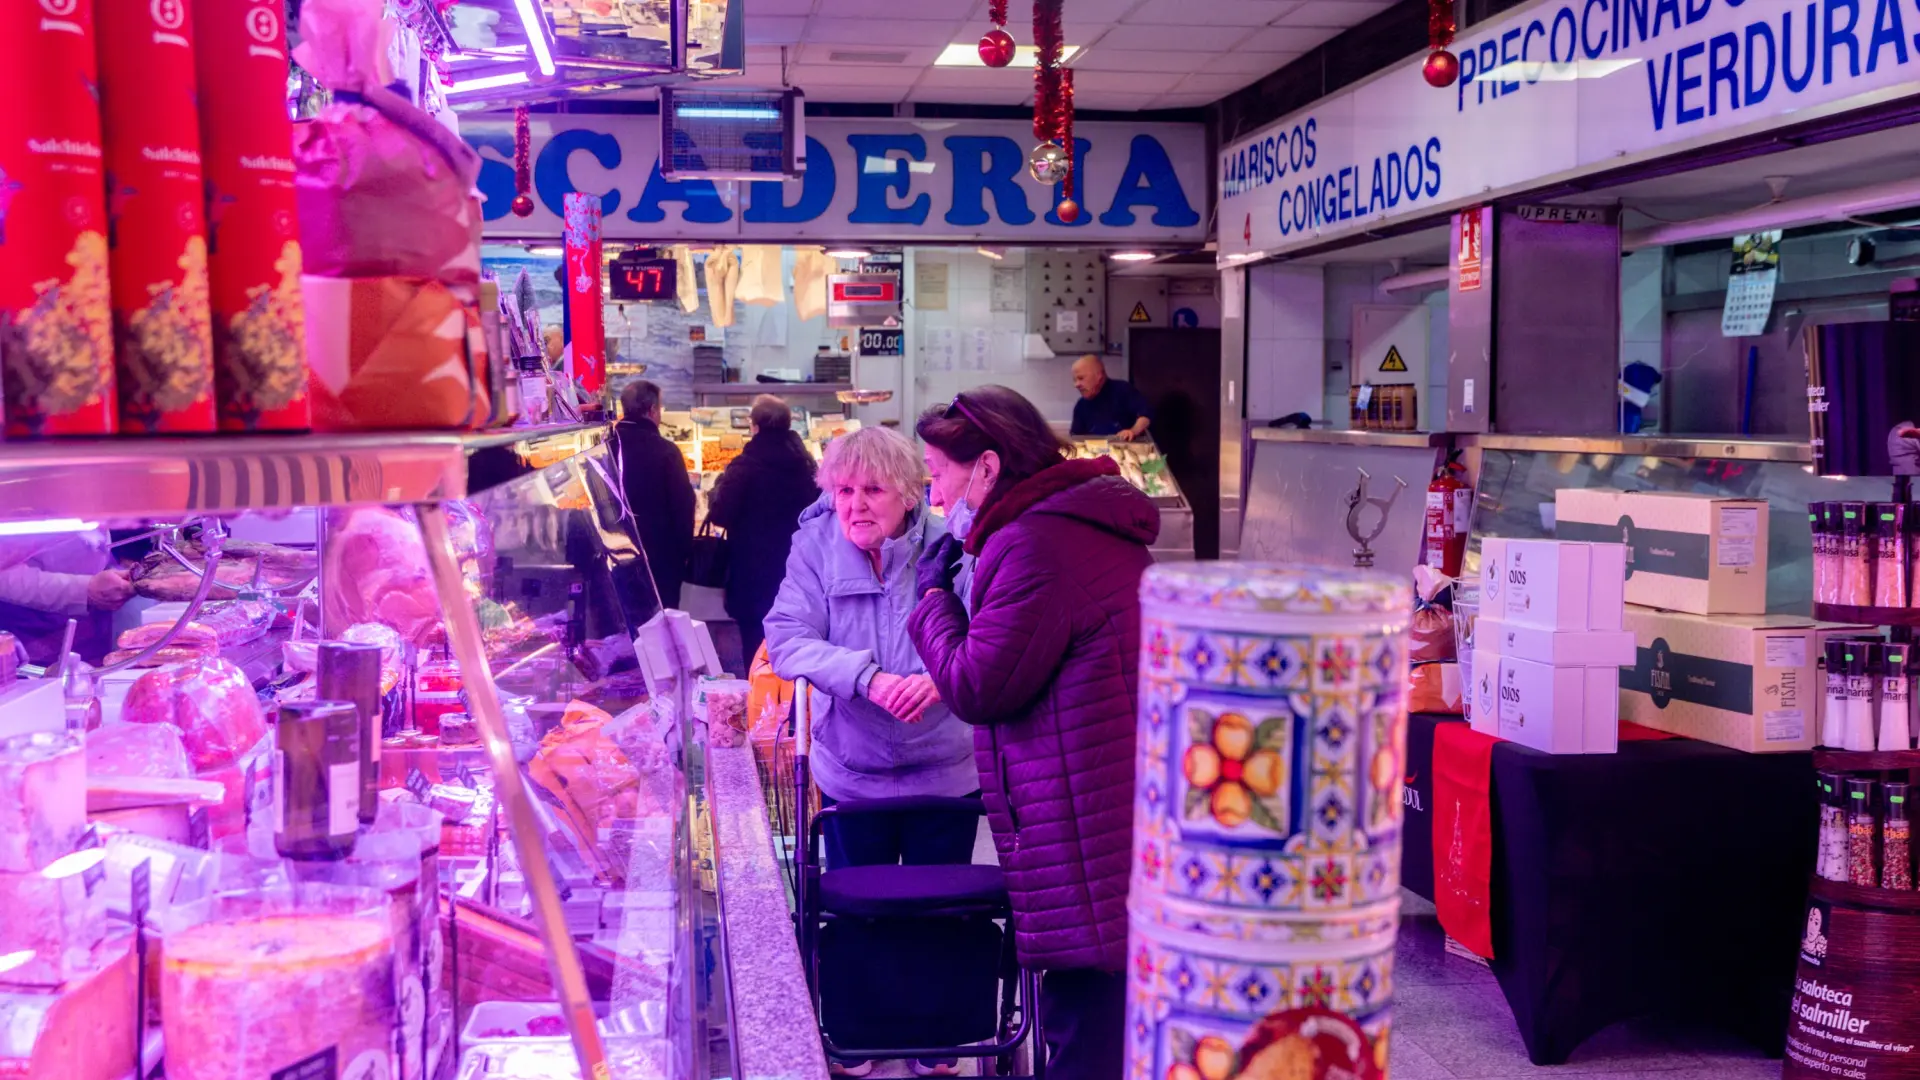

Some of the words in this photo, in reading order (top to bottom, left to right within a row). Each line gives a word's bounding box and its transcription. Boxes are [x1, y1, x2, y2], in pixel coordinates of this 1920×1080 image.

[1223, 117, 1317, 199] MARISCOS
[1279, 137, 1441, 236] CONGELADOS
[1243, 212, 1251, 246] 4
[626, 270, 662, 292] 47
[1509, 569, 1527, 585] OJOS
[1501, 686, 1520, 703] OJOS
[1801, 980, 1853, 1006] saloteca
[1800, 1003, 1870, 1034] salmiller
[1812, 1048, 1829, 1061] muy
[1829, 1053, 1867, 1068] personal
[1831, 1066, 1841, 1075] en
[1843, 1068, 1867, 1080] sales
